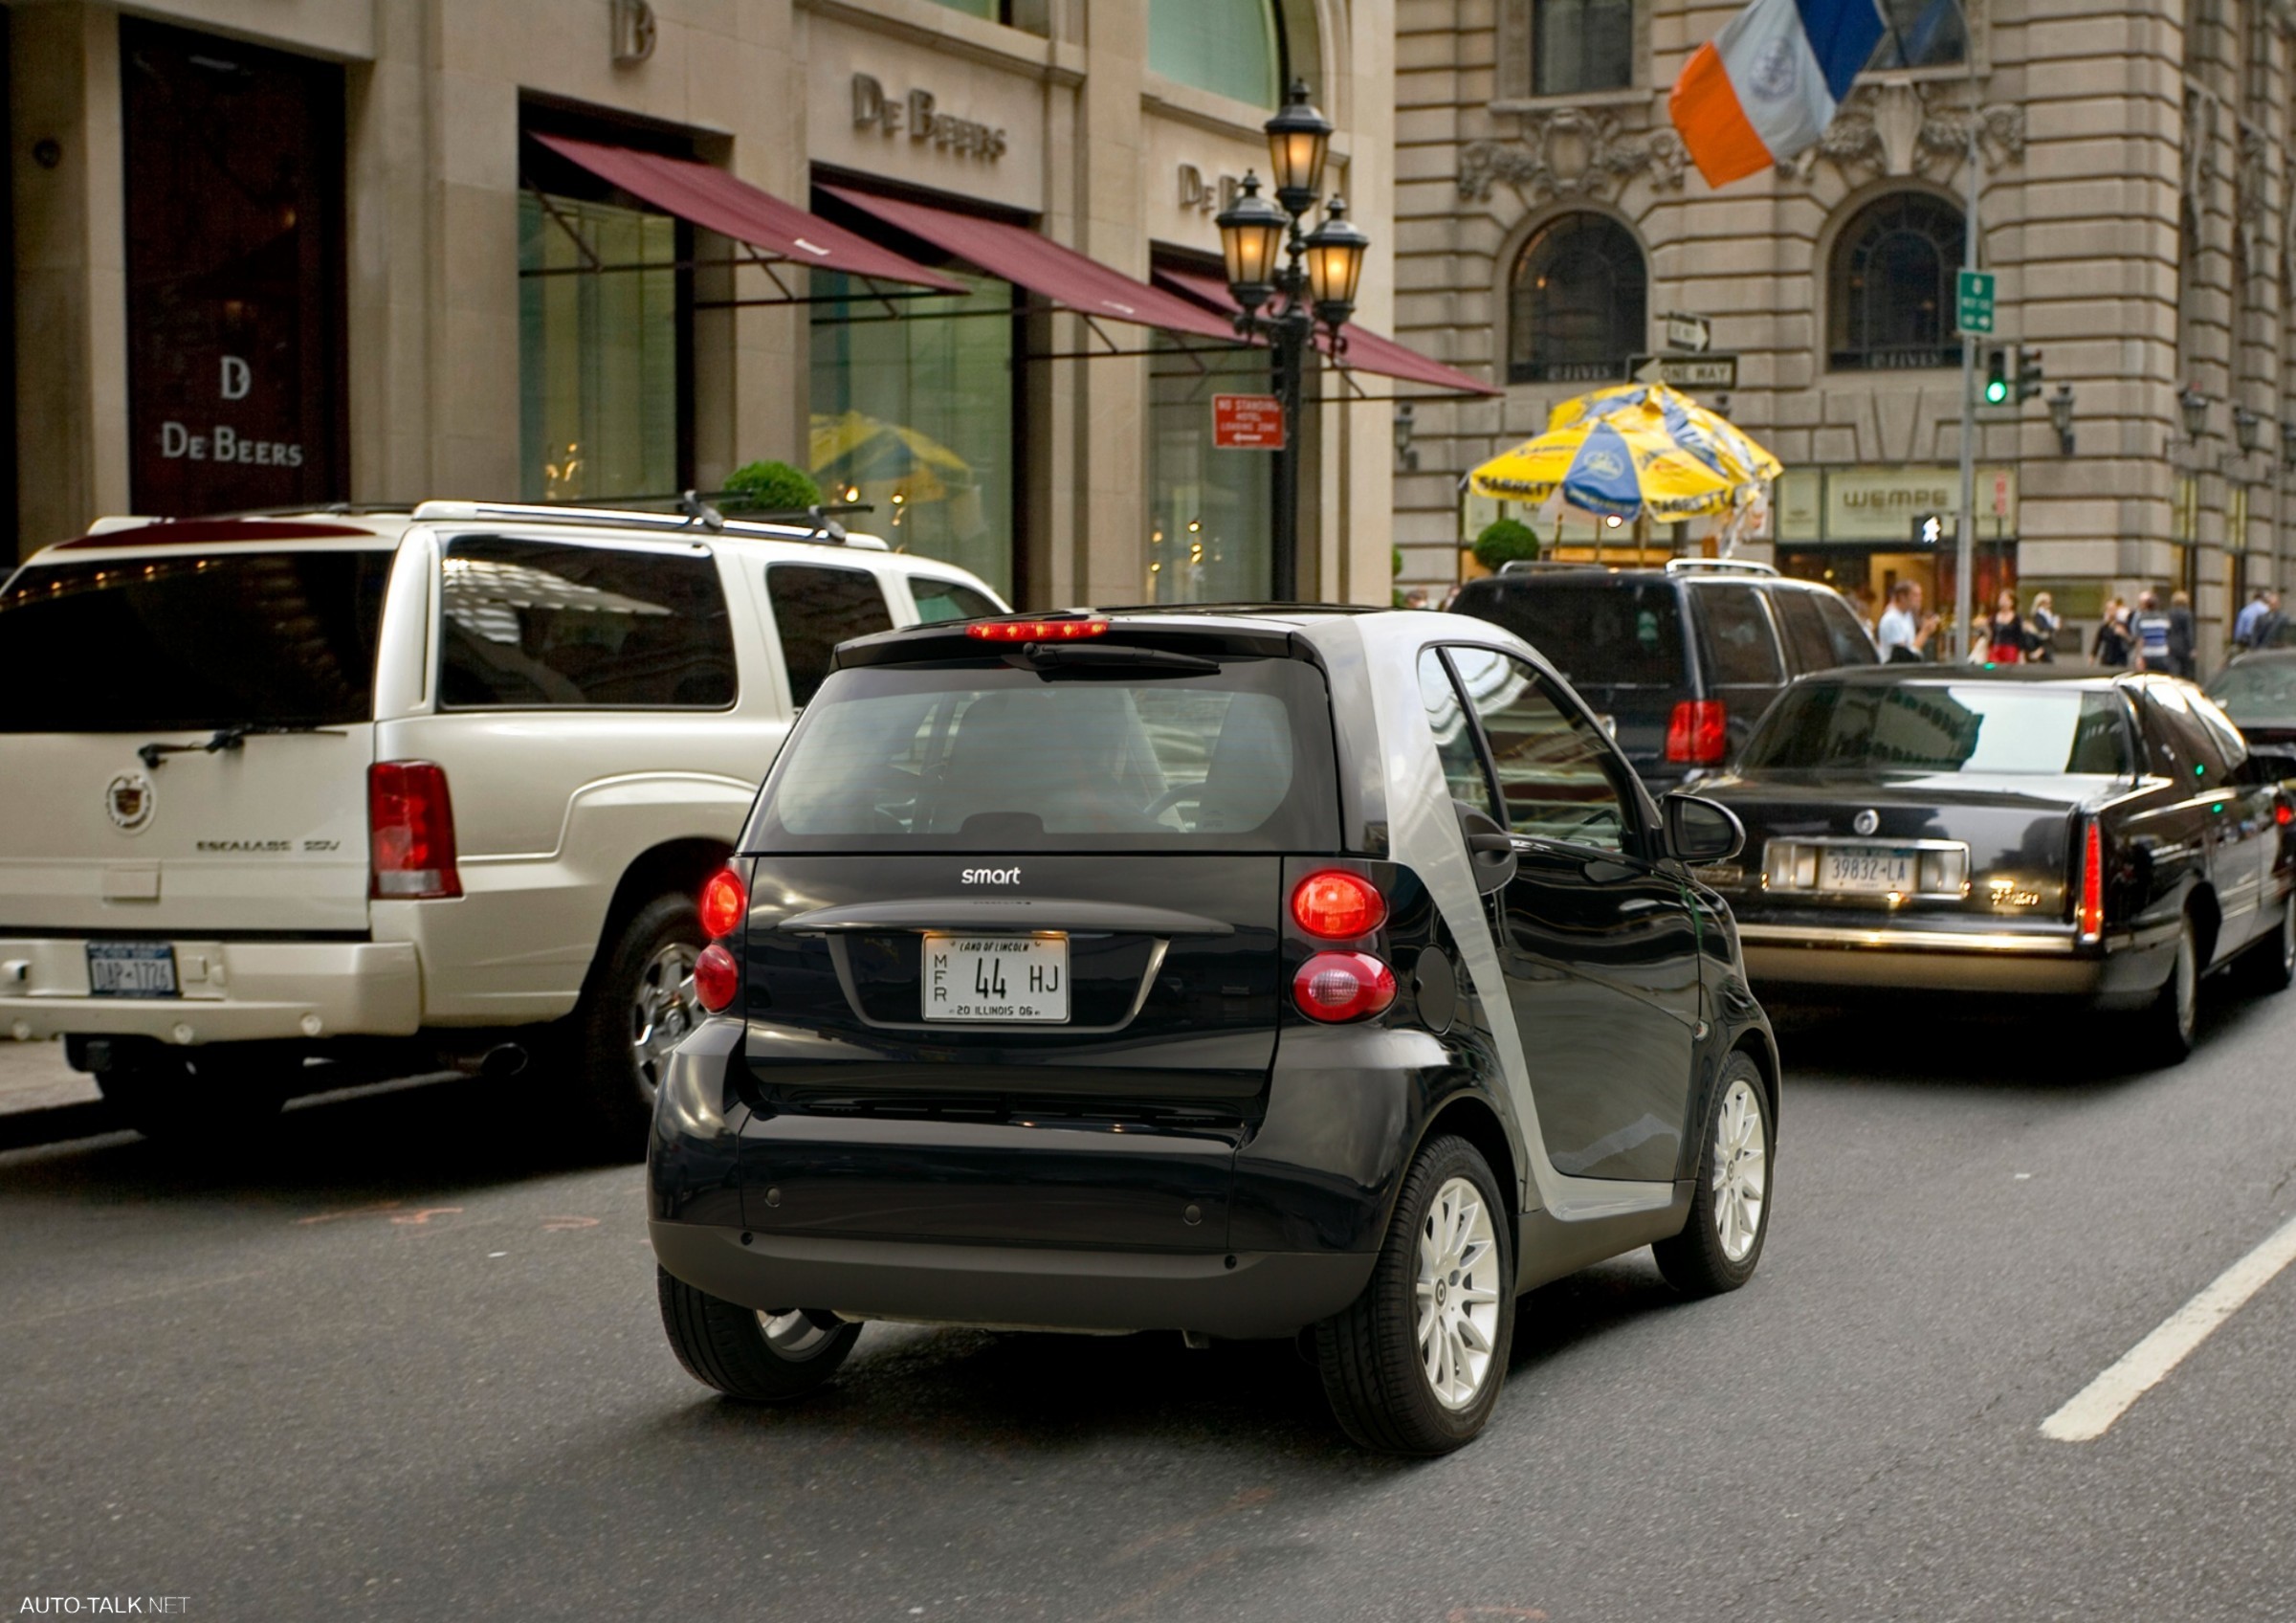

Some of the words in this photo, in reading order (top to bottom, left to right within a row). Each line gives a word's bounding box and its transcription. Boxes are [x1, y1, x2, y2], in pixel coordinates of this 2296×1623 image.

[1695, 366, 1728, 382] WAY
[1218, 399, 1232, 411] NO
[1843, 489, 1948, 508] WEMPE
[960, 867, 1021, 885] smart
[960, 942, 982, 952] LAND
[983, 941, 993, 951] OF
[995, 942, 1029, 952] LINCOLN
[975, 957, 1006, 999] 44
[1029, 965, 1058, 993] HJ
[958, 1006, 971, 1015] 20
[975, 1006, 1013, 1015] ILLINOIS
[1019, 1006, 1033, 1015] 06
